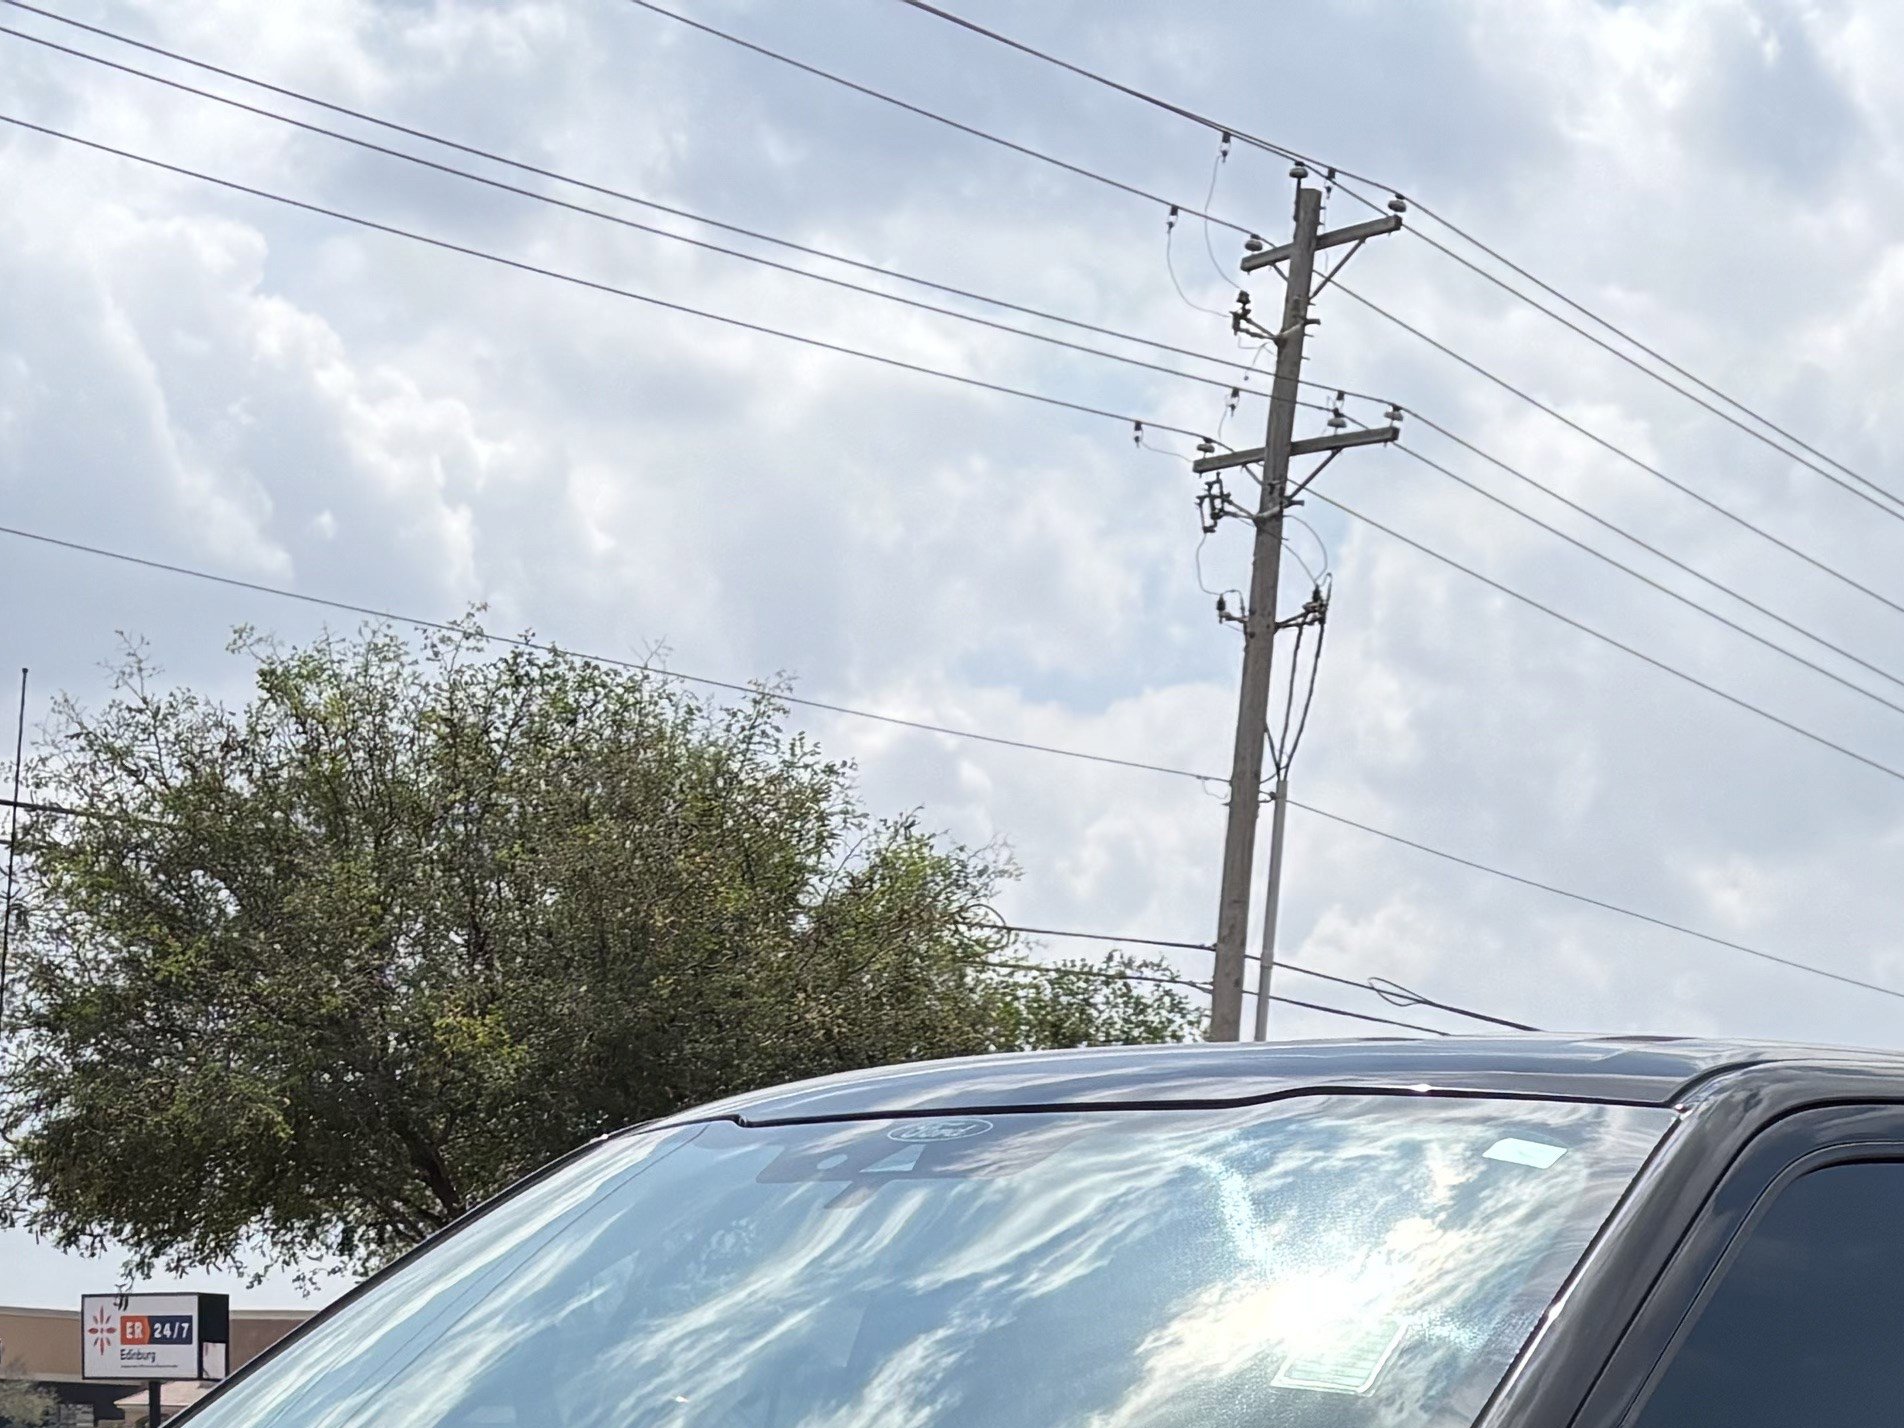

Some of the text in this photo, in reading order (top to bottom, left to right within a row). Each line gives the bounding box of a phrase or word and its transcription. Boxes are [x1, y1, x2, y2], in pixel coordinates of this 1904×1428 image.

[126, 1321, 190, 1339] ER 24/7
[120, 1348, 156, 1363] Edinburg
